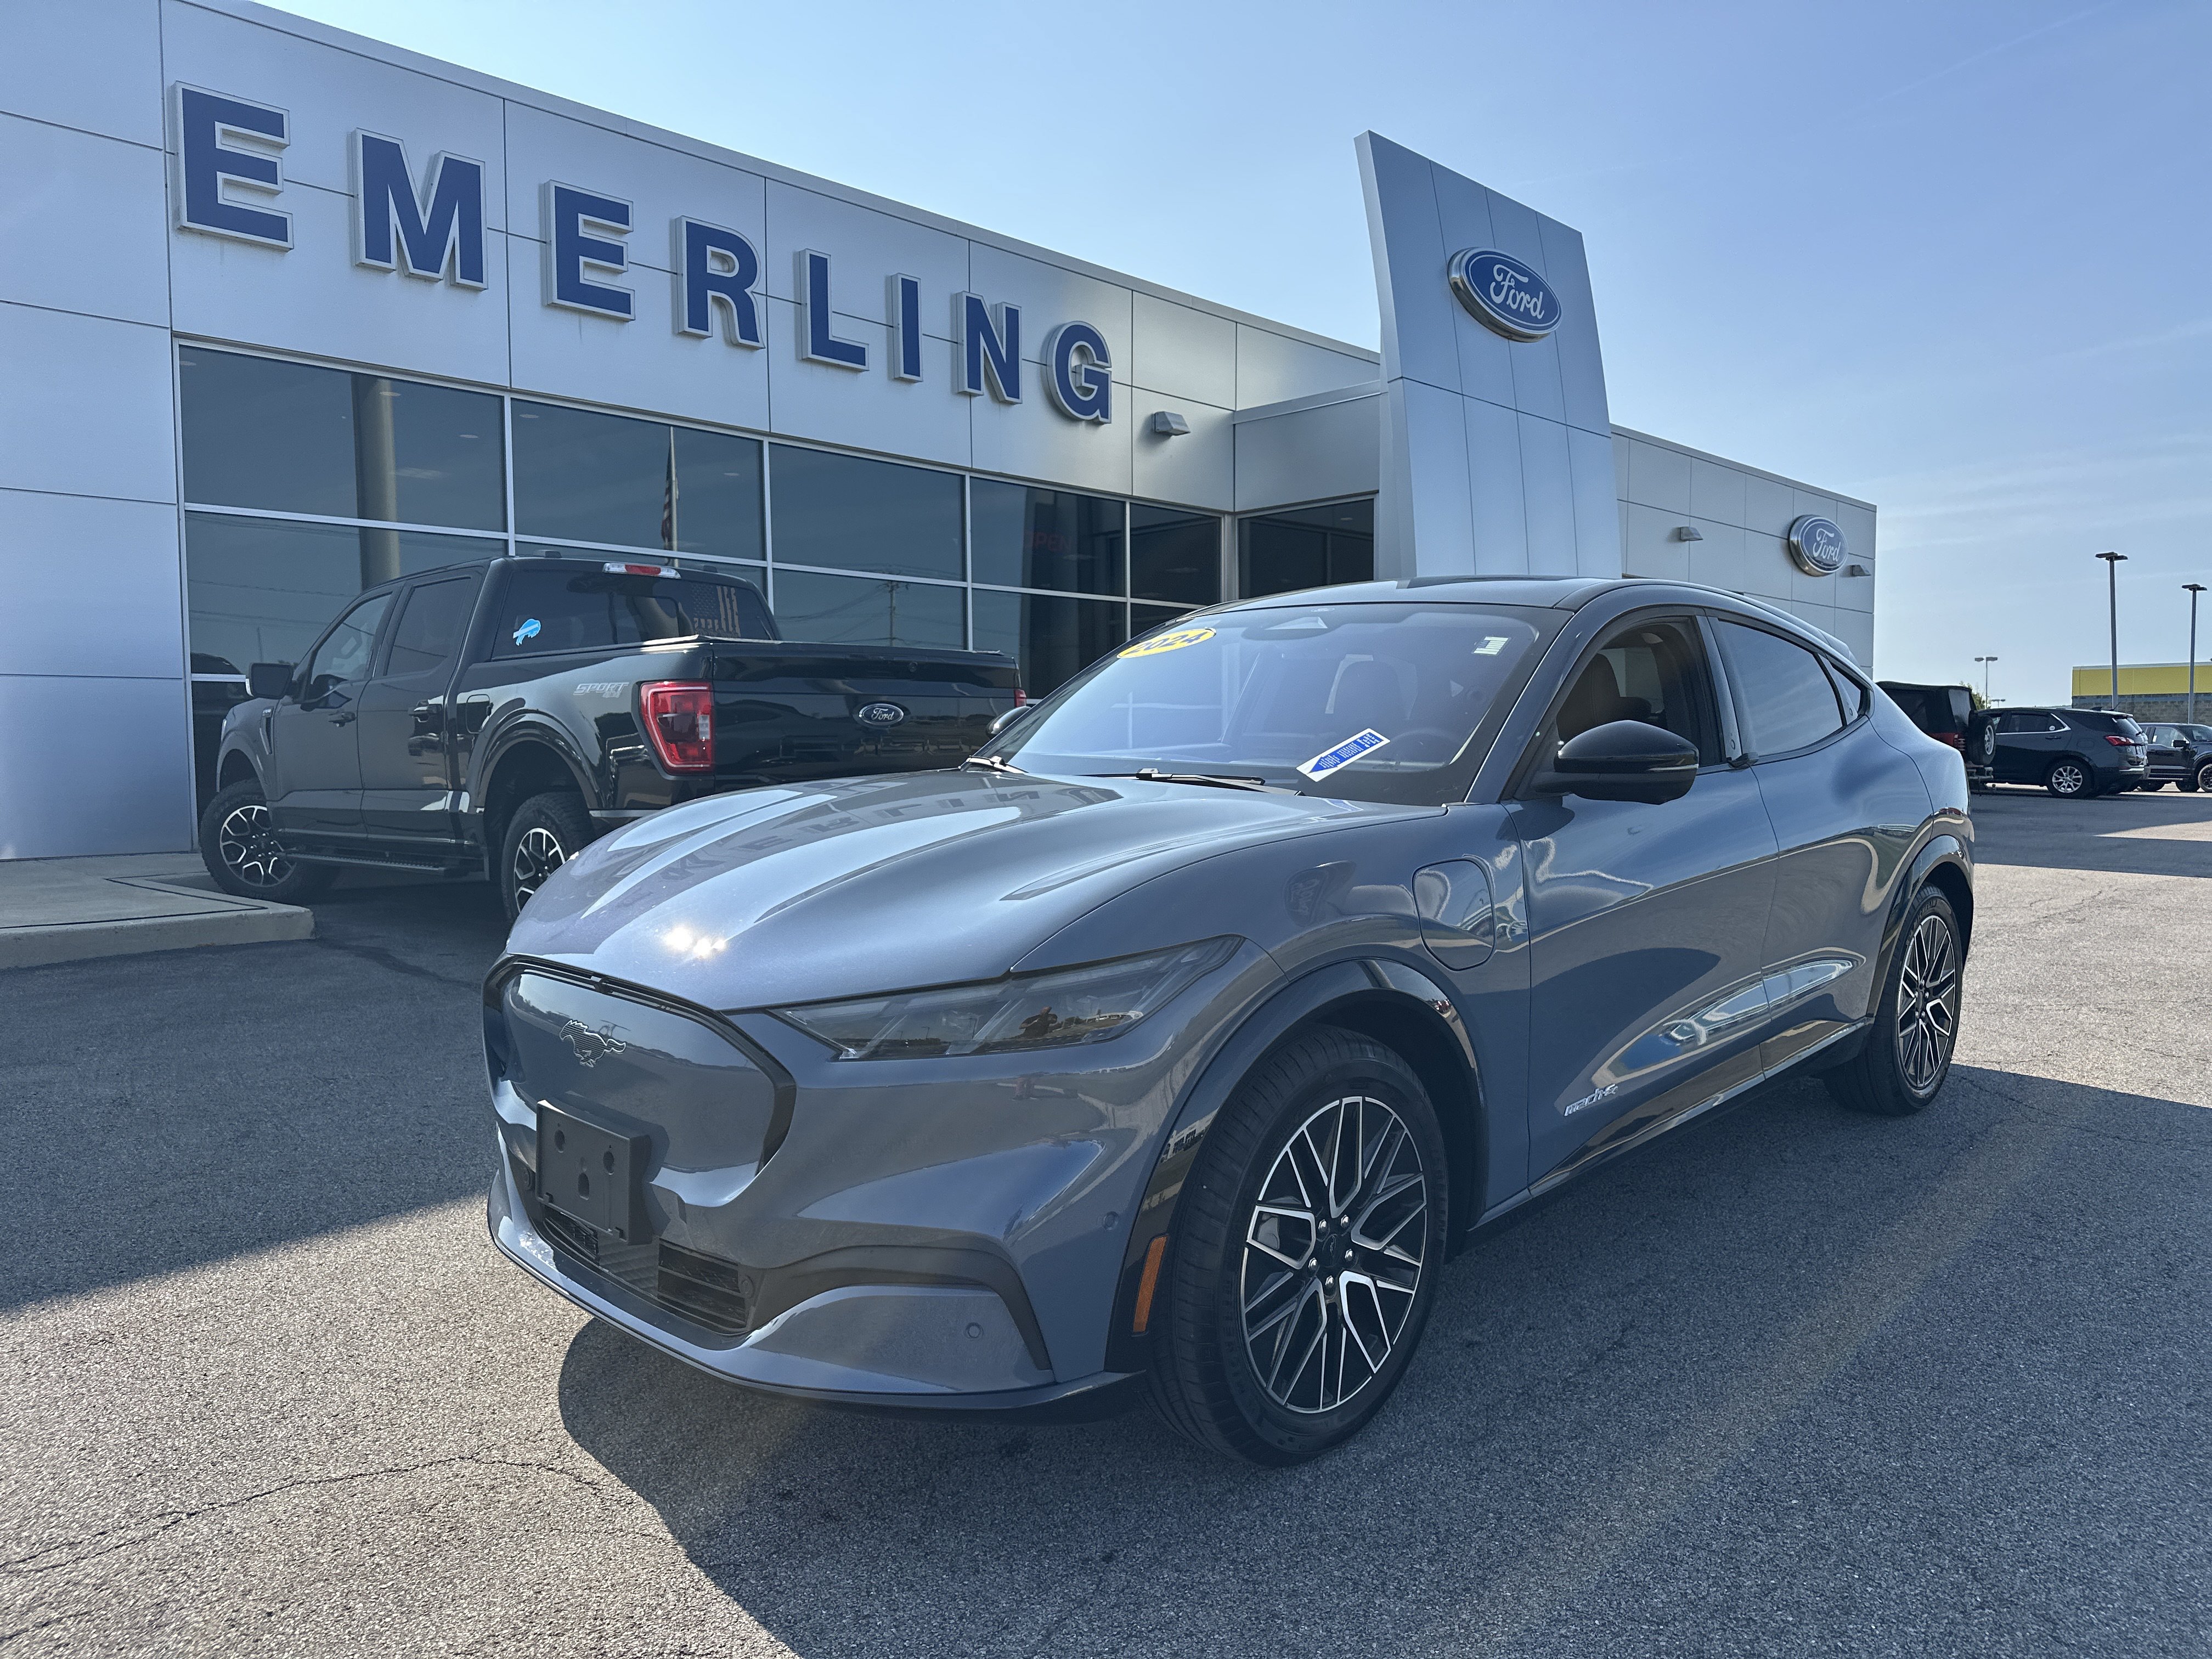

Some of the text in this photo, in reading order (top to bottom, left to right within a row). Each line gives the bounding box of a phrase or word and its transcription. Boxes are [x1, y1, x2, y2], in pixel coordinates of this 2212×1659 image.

[174, 81, 1113, 425] EMERLING
[1489, 264, 1545, 319] Ford
[1812, 528, 1841, 562] Ford
[1121, 631, 1209, 657] 2024
[573, 681, 629, 696] SPORT
[871, 707, 895, 721] Ford
